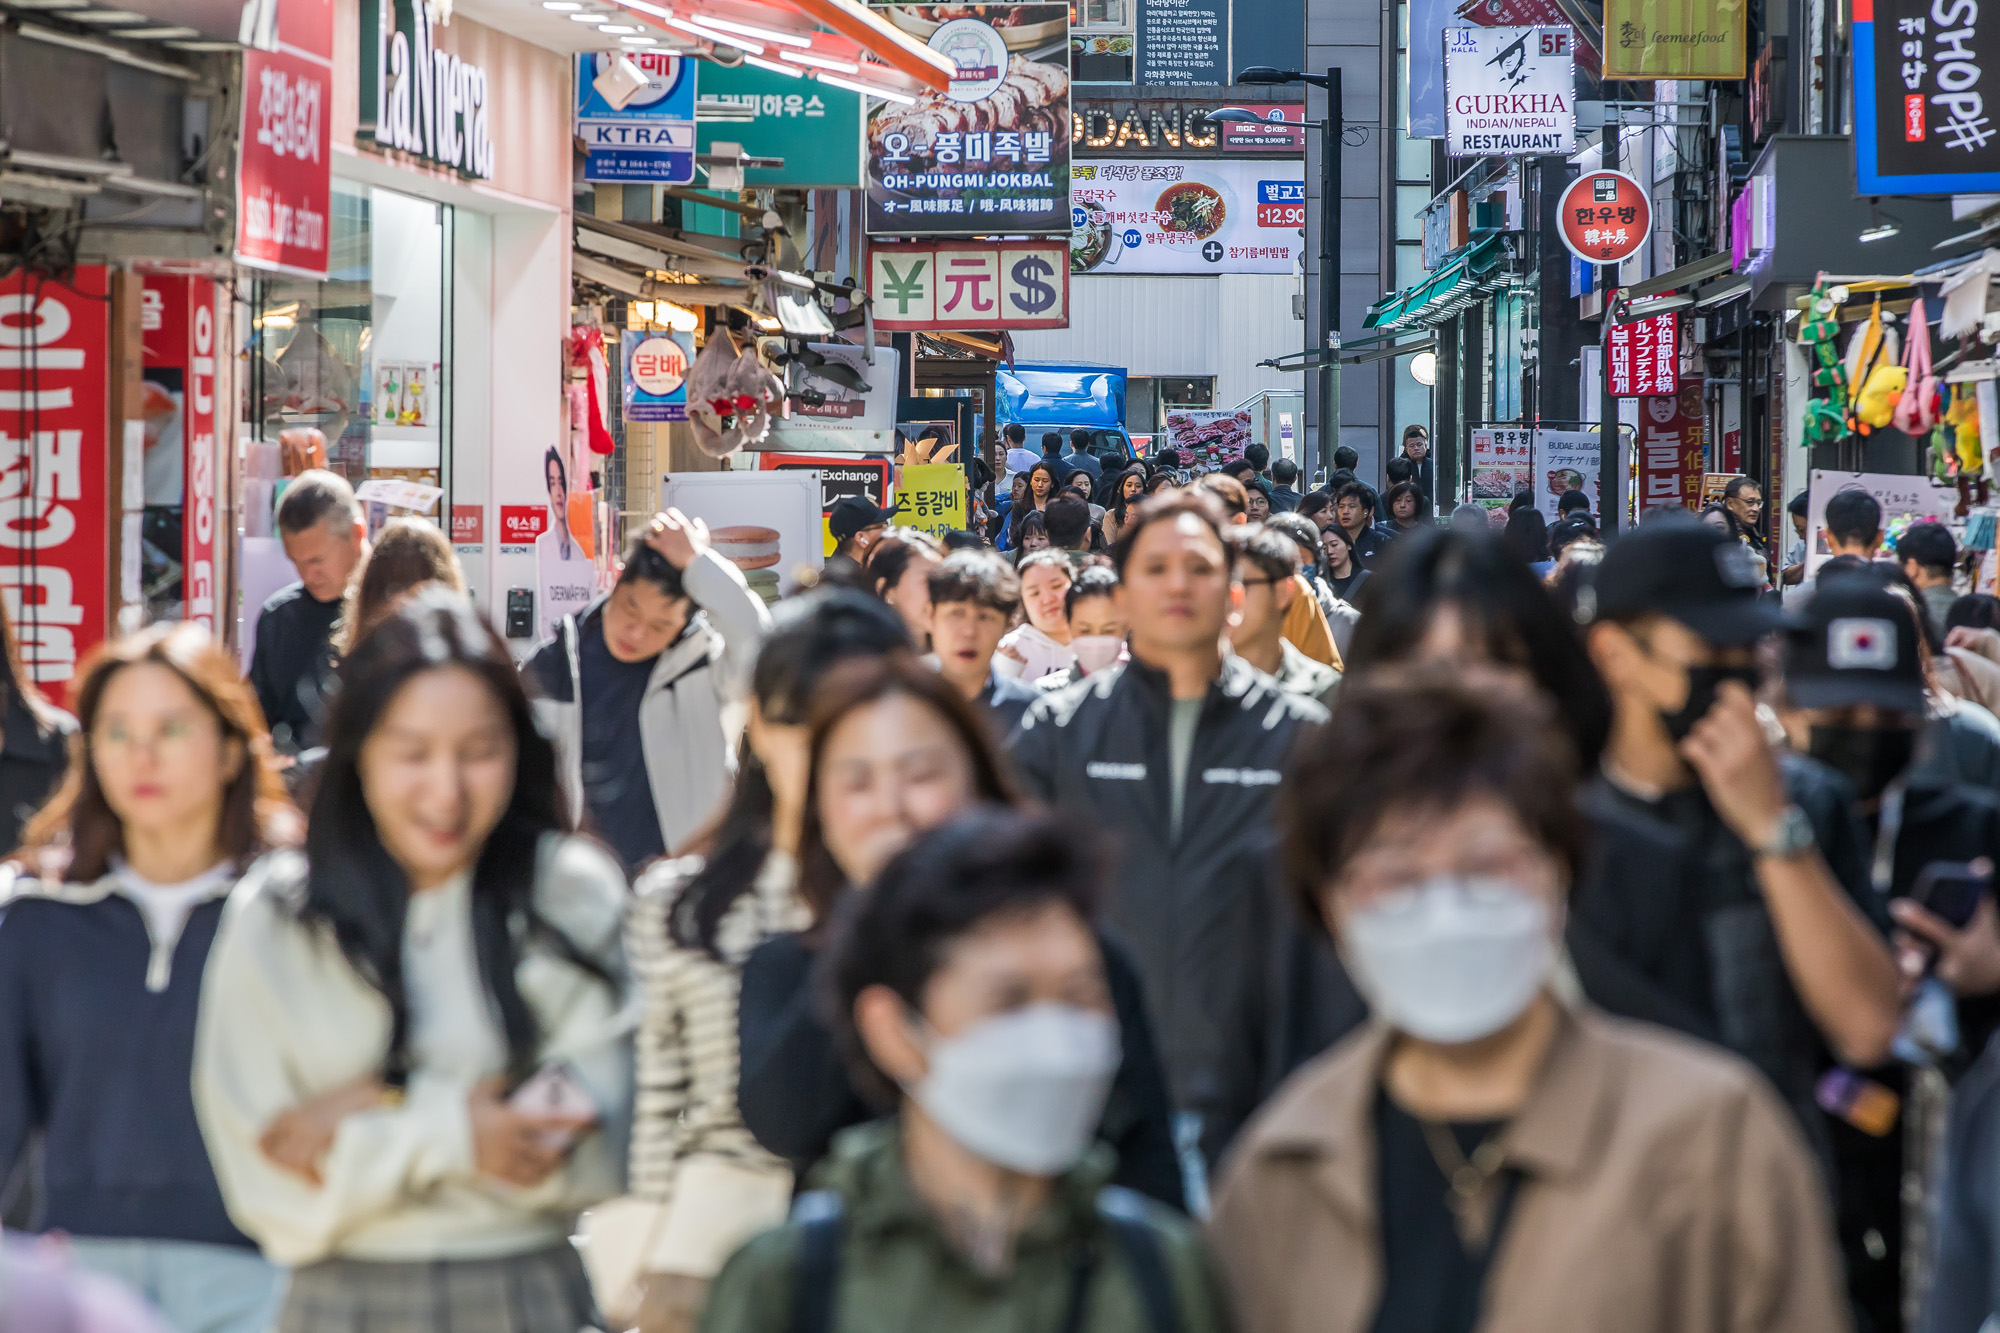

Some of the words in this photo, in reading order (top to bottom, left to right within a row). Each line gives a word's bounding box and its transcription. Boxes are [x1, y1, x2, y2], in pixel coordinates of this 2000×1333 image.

[1541, 34, 1567, 54] 5F
[1652, 30, 1729, 48] leemeefood
[375, 0, 412, 150] La
[411, 0, 495, 181] Nueva
[1455, 94, 1568, 115] GURKHA
[1466, 117, 1557, 129] INDIAN/NEPALI
[596, 126, 674, 145] KTRA
[1463, 134, 1562, 150] RESTAURANT
[883, 131, 1053, 163] 오-풍미족발
[883, 174, 984, 189] OH-PUNGMI
[986, 173, 1054, 188] JOKBAL
[1101, 165, 1140, 181] 더식당
[1141, 166, 1184, 181] 꿀조합!
[1094, 211, 1172, 225] 들깨버섯칼국수
[1575, 206, 1637, 226] 한우방
[1124, 233, 1141, 245] or
[1145, 232, 1197, 246] 열무냉국수
[1584, 228, 1629, 247] 韓牛房
[1229, 246, 1290, 260] 참기름비빔밥
[942, 258, 993, 313] 元
[1009, 254, 1057, 315] $
[1611, 305, 1630, 394] 부대찌개
[1634, 319, 1654, 394] ルブプデチゲ
[635, 353, 681, 377] 담배
[1494, 432, 1529, 445] 한우방
[1549, 442, 1573, 450] BUDAE
[820, 469, 878, 482] Exchange
[915, 490, 958, 516] 등갈비
